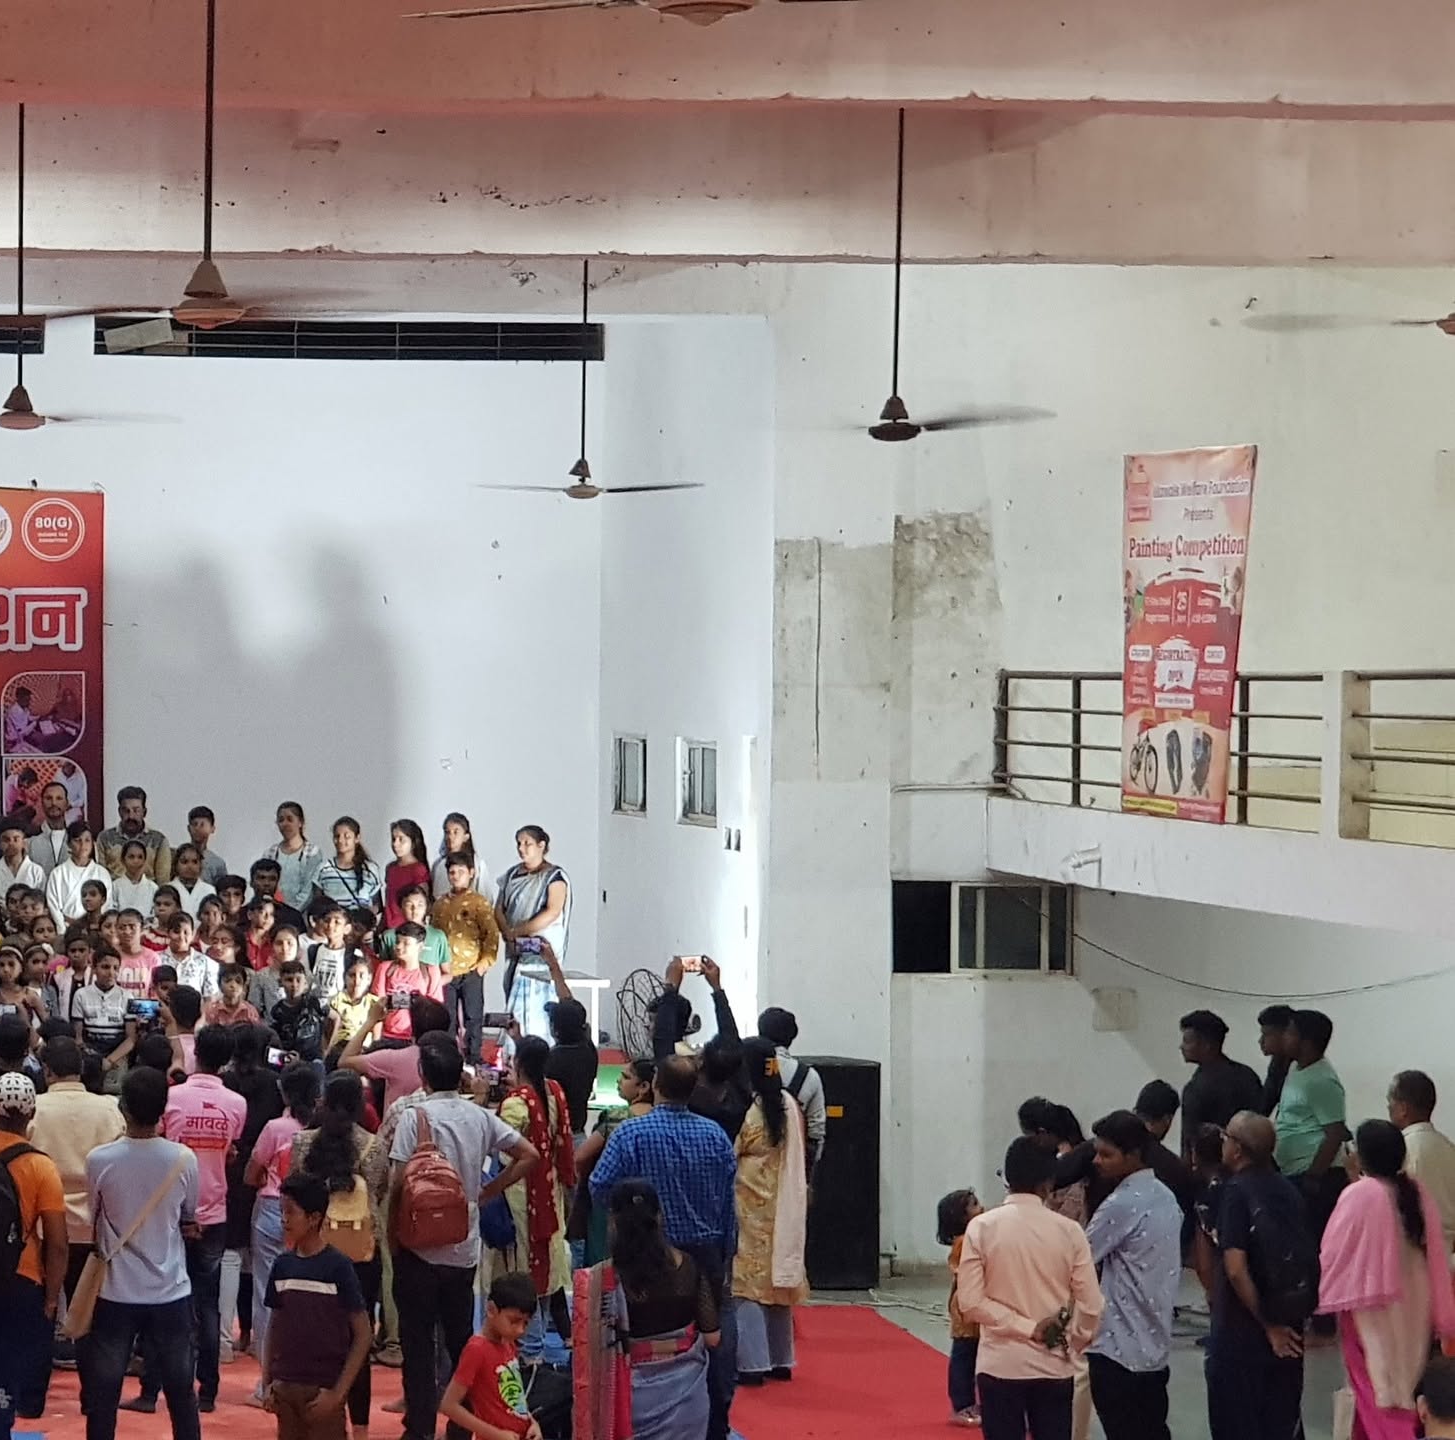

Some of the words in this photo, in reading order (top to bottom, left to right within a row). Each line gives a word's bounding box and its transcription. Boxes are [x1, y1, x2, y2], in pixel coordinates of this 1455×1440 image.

[35, 516, 72, 531] 80(G)
[1129, 537, 1172, 562] Painting
[1175, 533, 1245, 561] Competition
